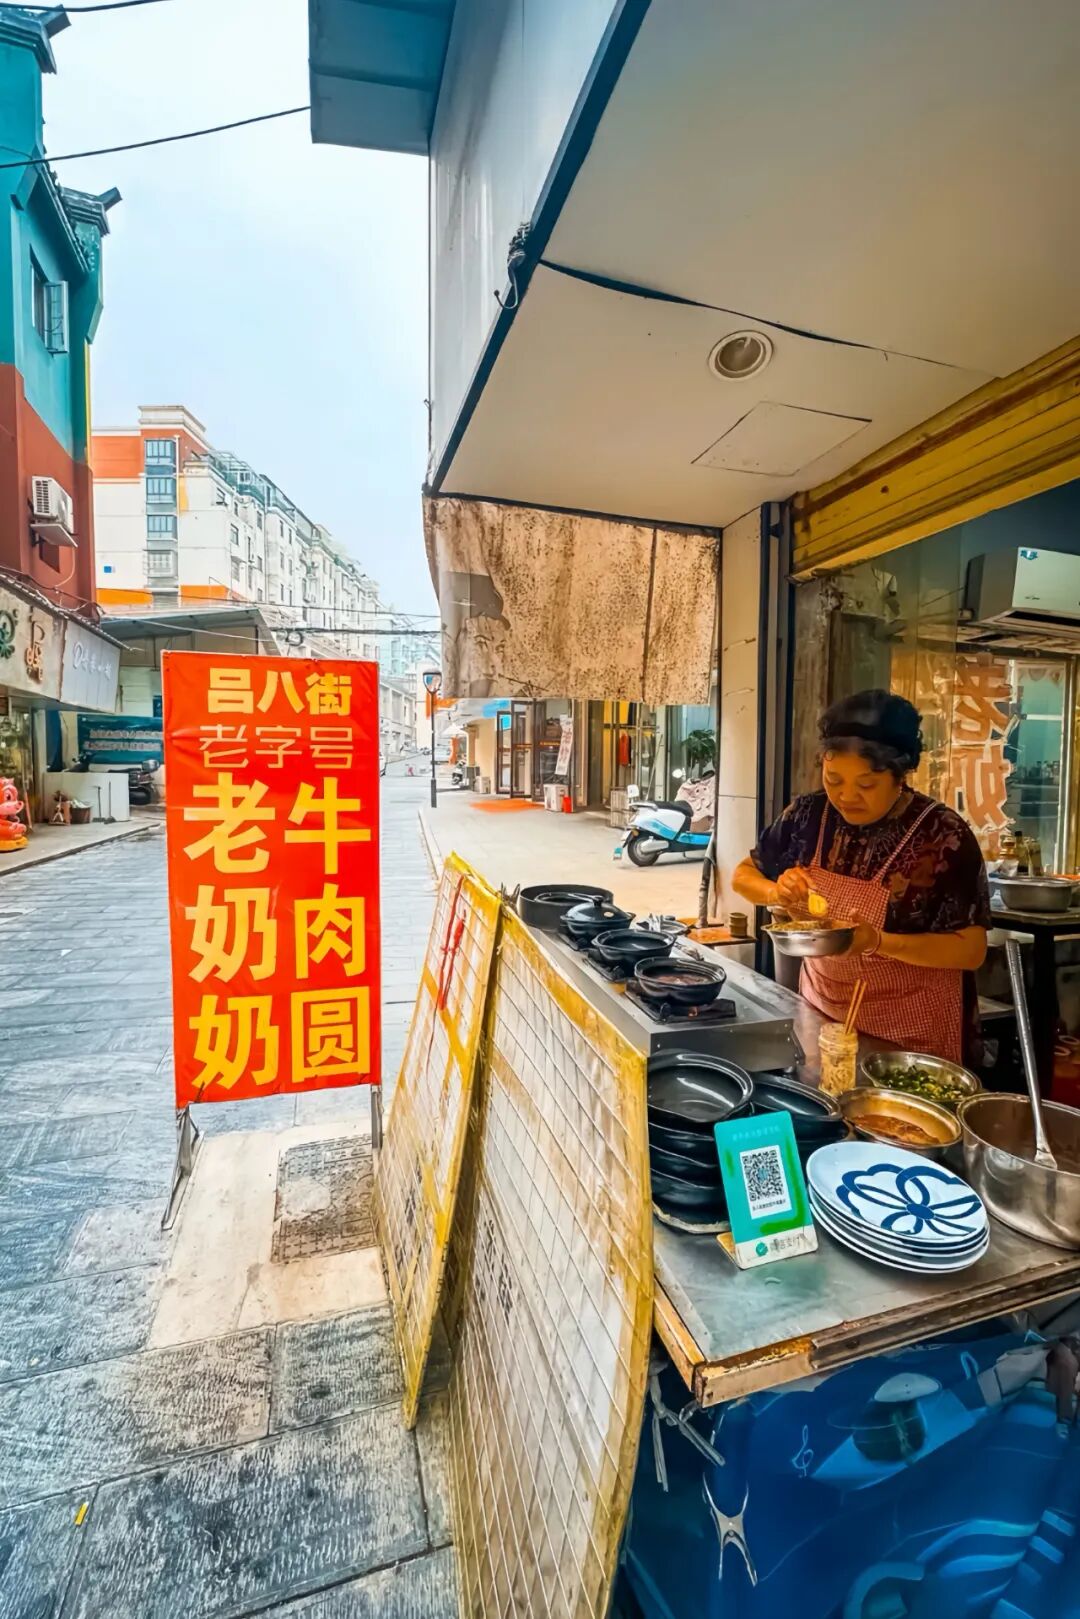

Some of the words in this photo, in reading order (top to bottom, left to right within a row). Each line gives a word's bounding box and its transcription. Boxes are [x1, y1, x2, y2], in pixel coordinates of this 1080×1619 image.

[199, 724, 354, 769] 老字号
[207, 667, 353, 716] 吕八街
[183, 772, 280, 1090] 老奶奶
[284, 777, 371, 1083] 牛肉圆
